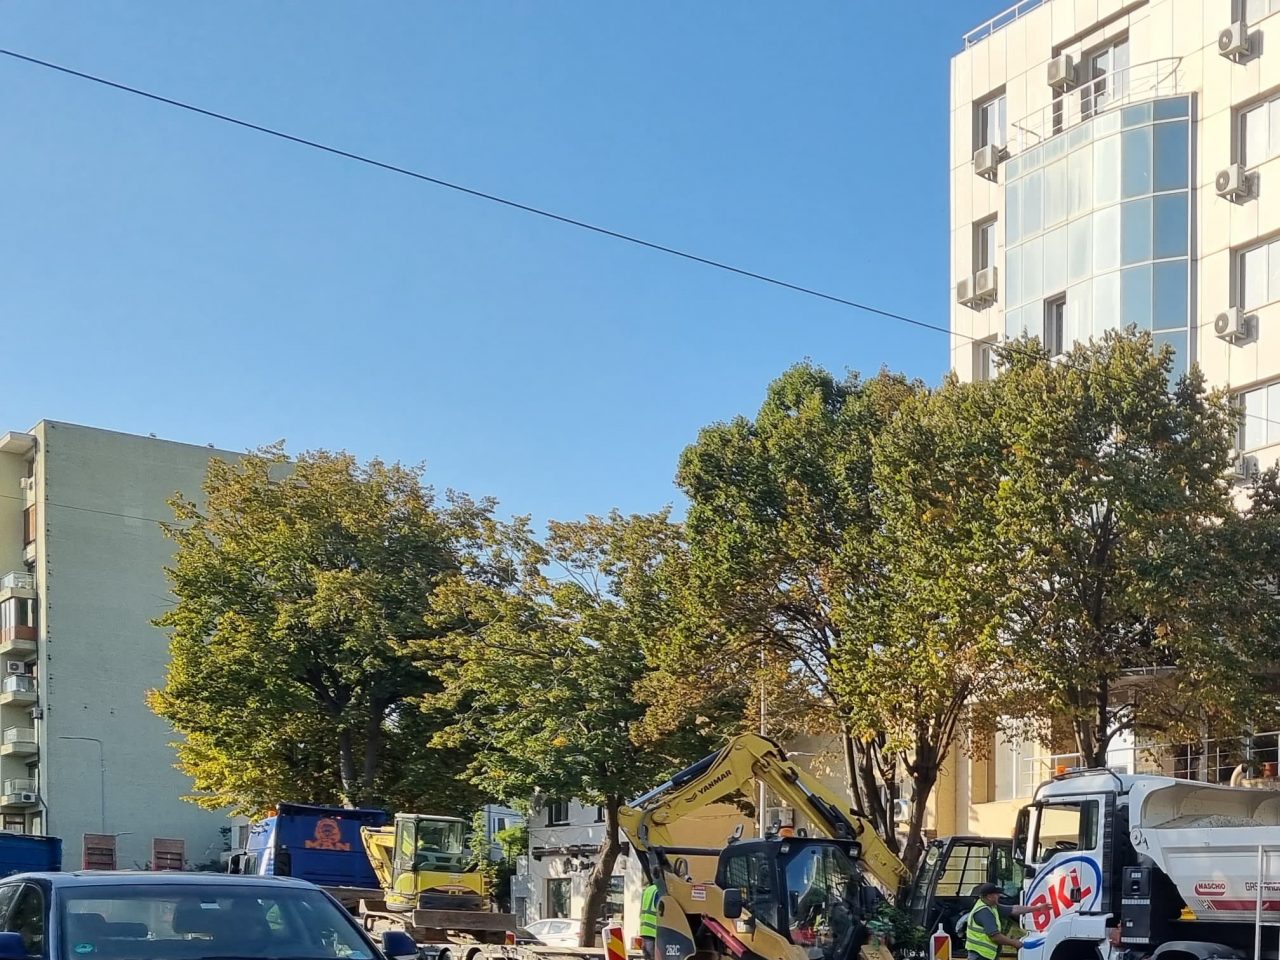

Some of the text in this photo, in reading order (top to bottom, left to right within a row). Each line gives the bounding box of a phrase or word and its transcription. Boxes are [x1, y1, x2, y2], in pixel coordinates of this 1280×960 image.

[697, 769, 732, 795] YANMAR
[304, 839, 351, 851] MAN
[1198, 882, 1226, 890] MASCHIO
[1030, 867, 1092, 933] BKL
